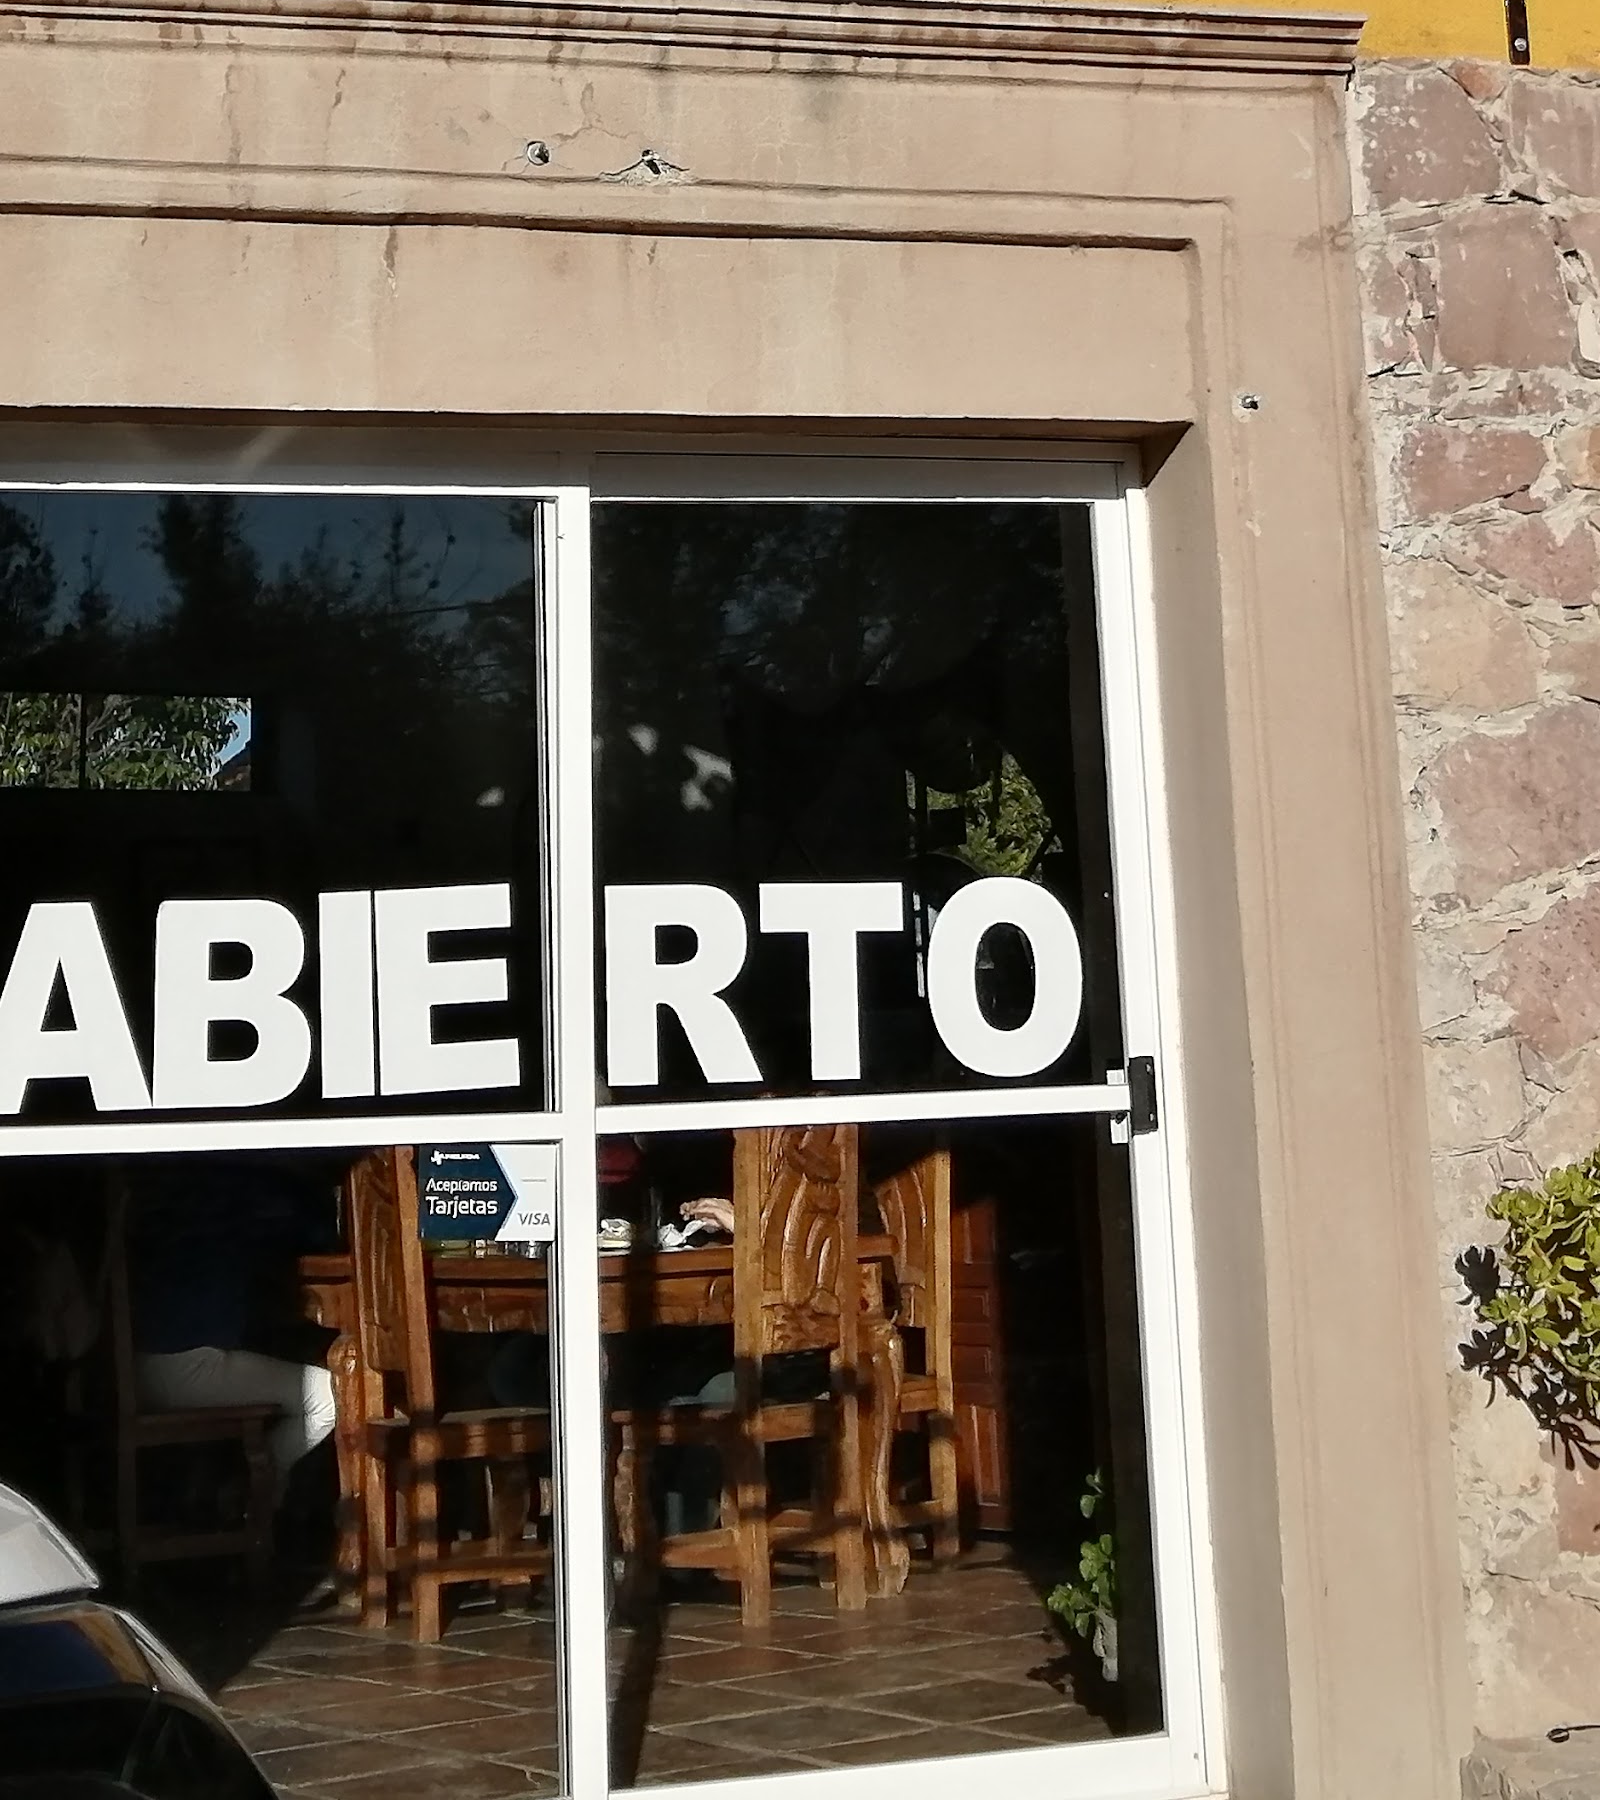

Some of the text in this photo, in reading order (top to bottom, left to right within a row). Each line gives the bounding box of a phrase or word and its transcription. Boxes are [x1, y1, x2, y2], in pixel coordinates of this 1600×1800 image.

[425, 1178, 498, 1194] Aceptamos
[425, 1196, 499, 1219] Tarjetas
[518, 1213, 551, 1226] VISA
